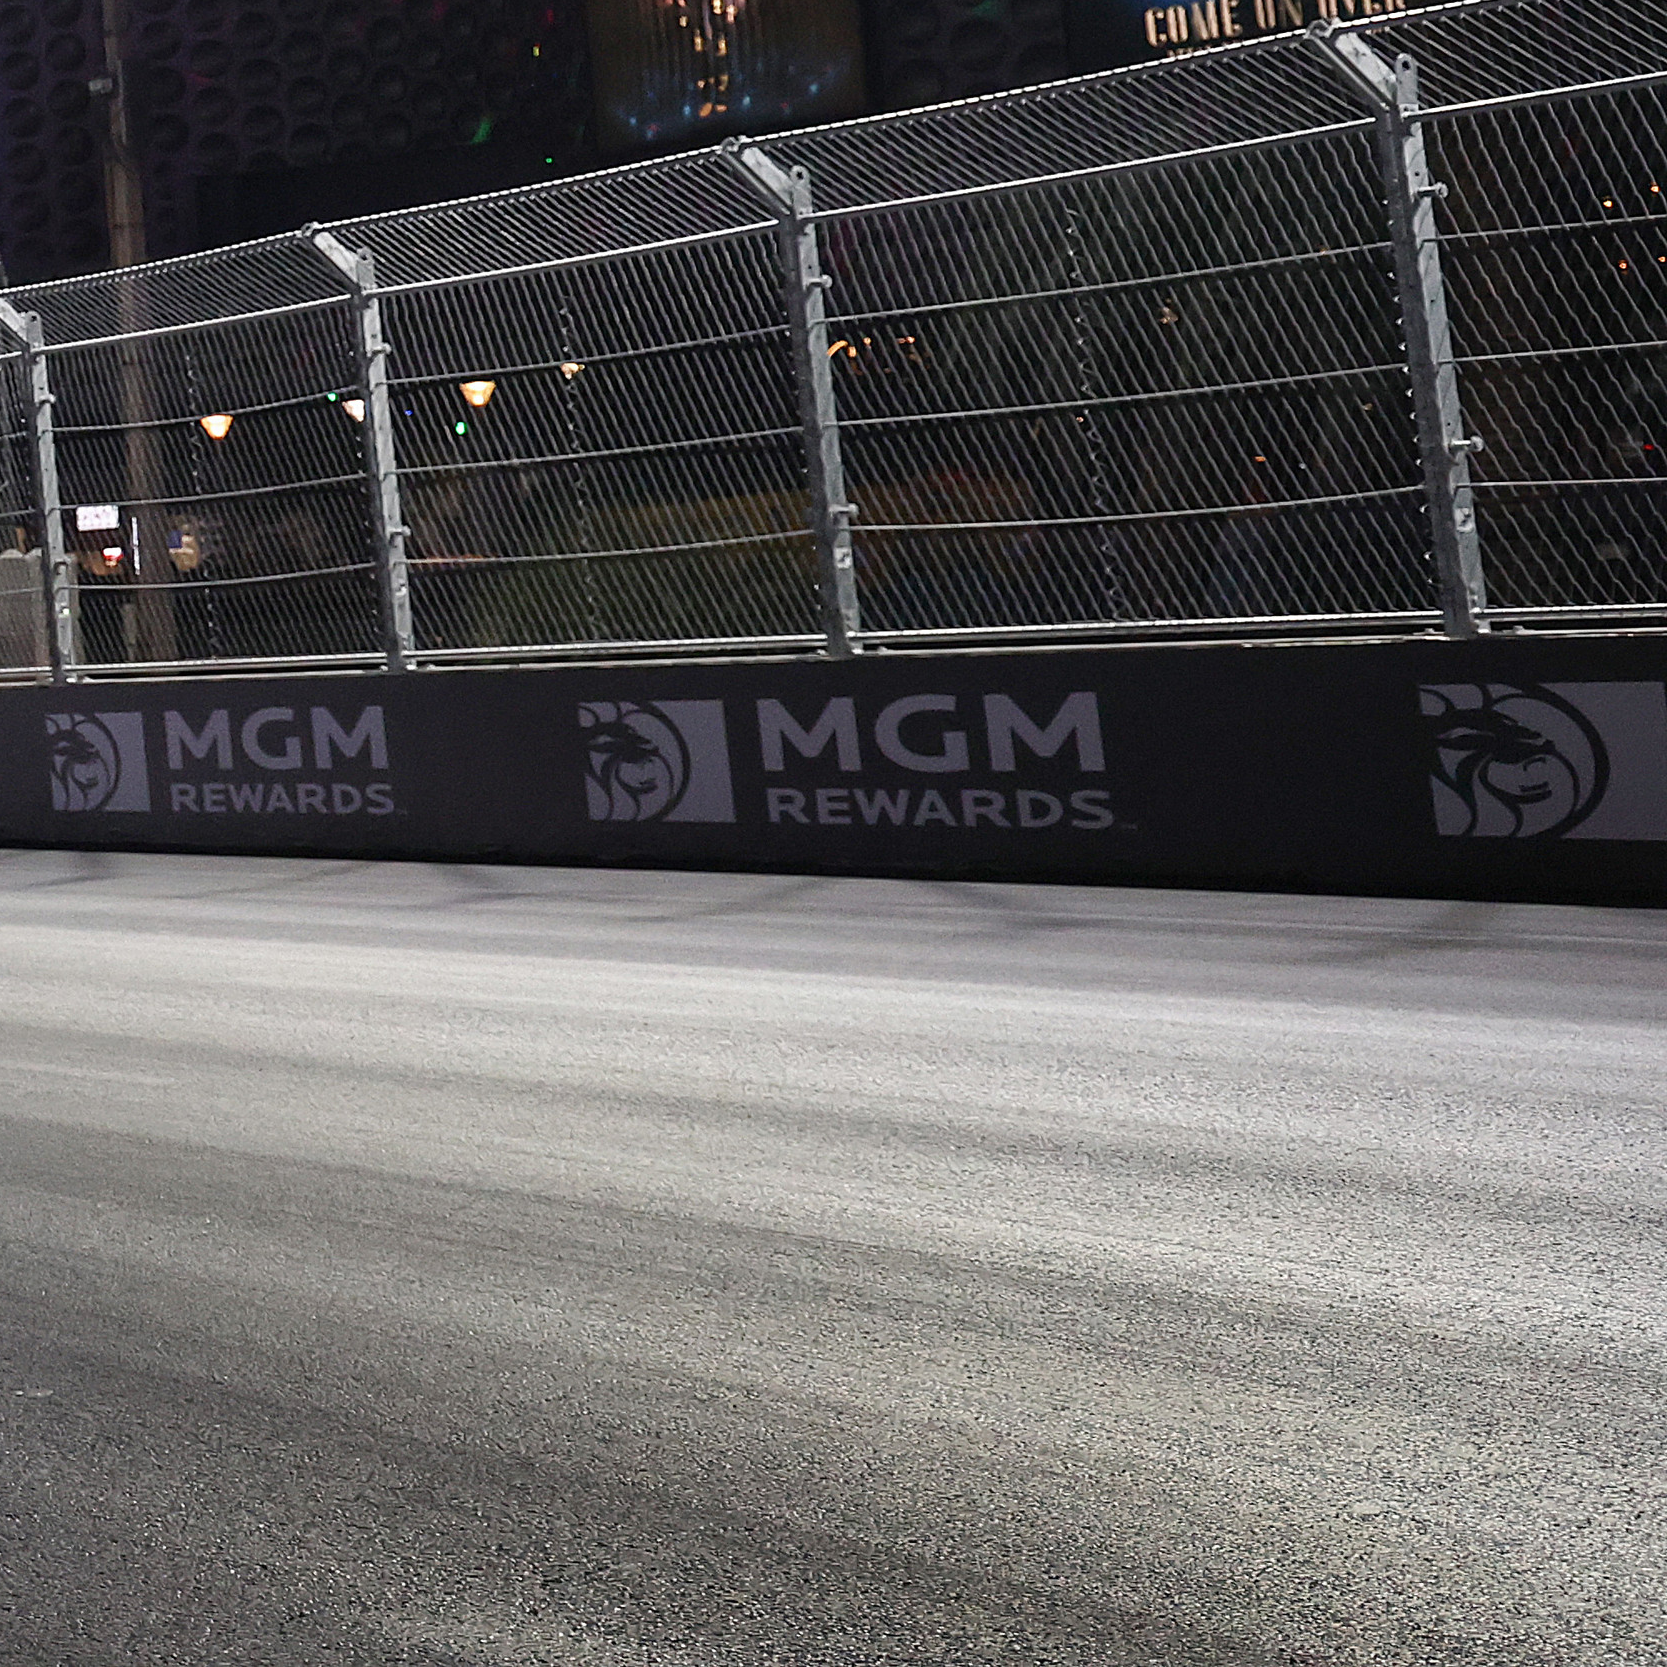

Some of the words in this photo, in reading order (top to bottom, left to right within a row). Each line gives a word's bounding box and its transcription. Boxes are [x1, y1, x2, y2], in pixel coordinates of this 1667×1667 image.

[163, 705, 389, 771] MGM
[756, 691, 1106, 773] MGM
[170, 783, 395, 815] REWARDS
[767, 787, 1115, 830] REWARDS
